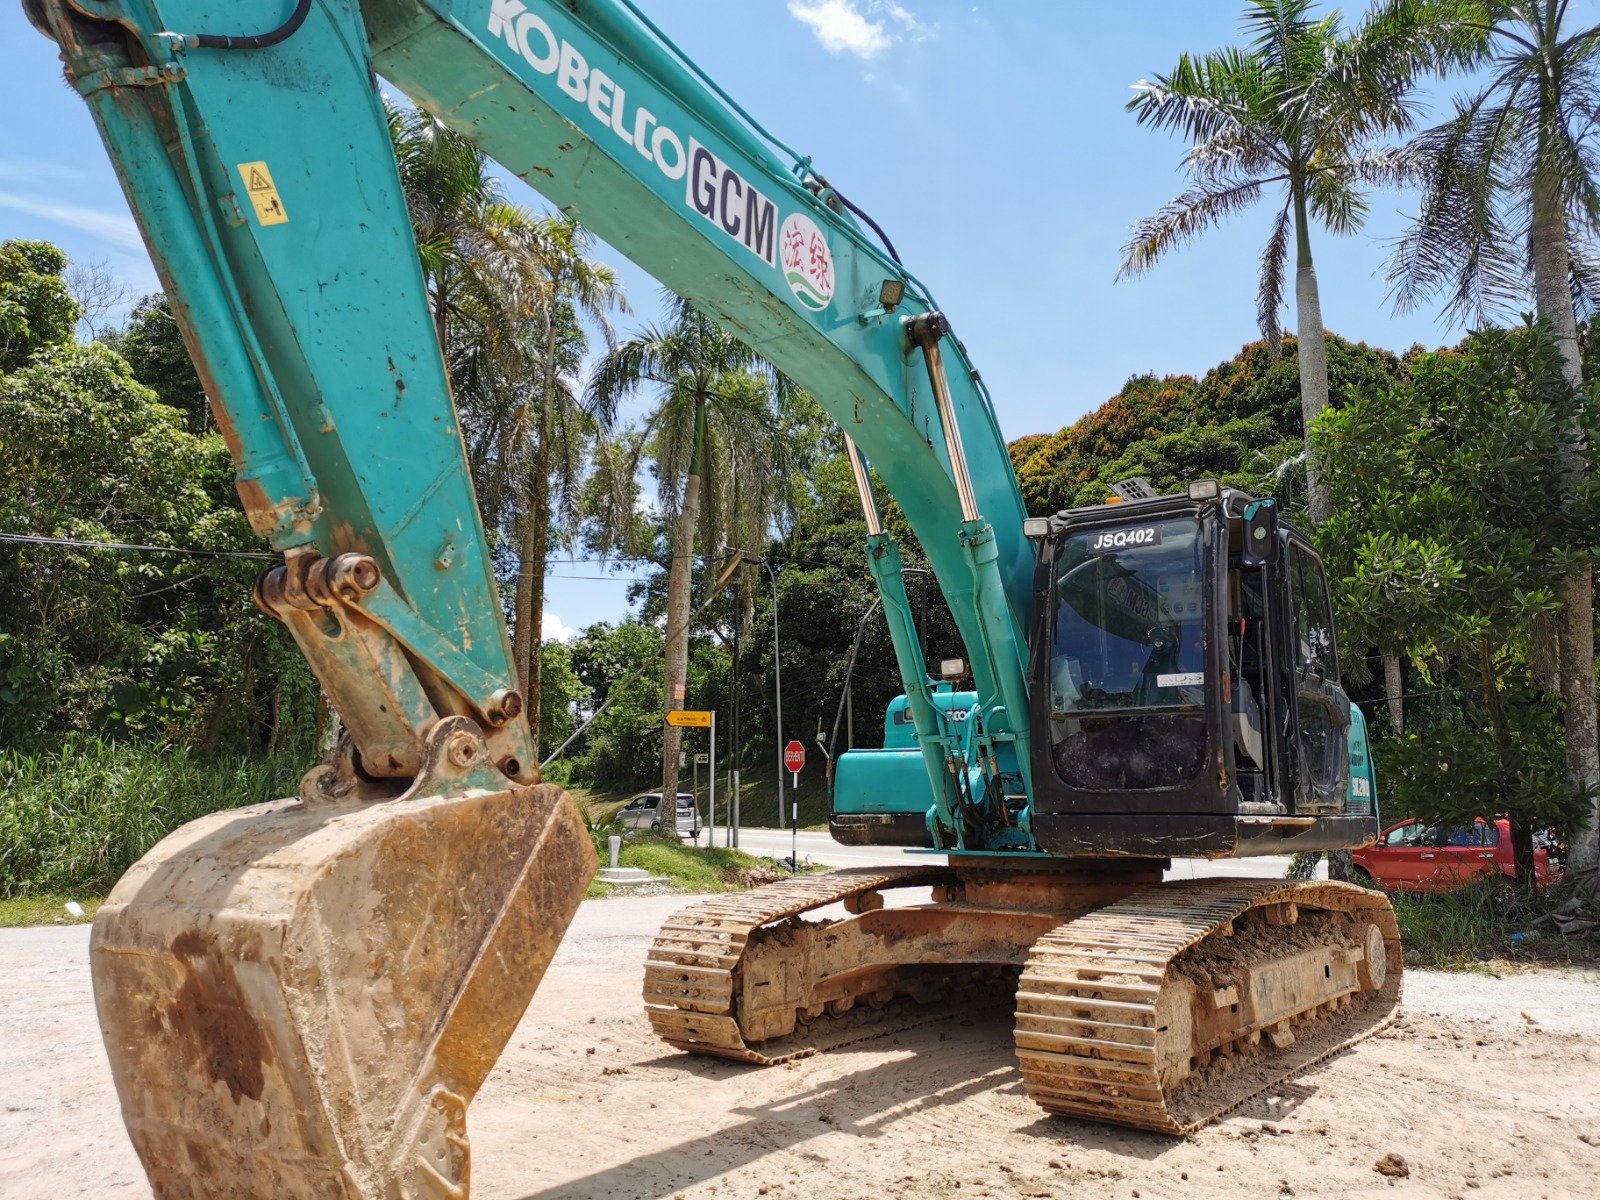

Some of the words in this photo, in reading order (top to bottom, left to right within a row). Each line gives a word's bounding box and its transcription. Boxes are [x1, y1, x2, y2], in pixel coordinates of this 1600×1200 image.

[487, 0, 687, 180] KOBELCO
[692, 146, 775, 263] GCM
[1093, 528, 1155, 549] JSQ402
